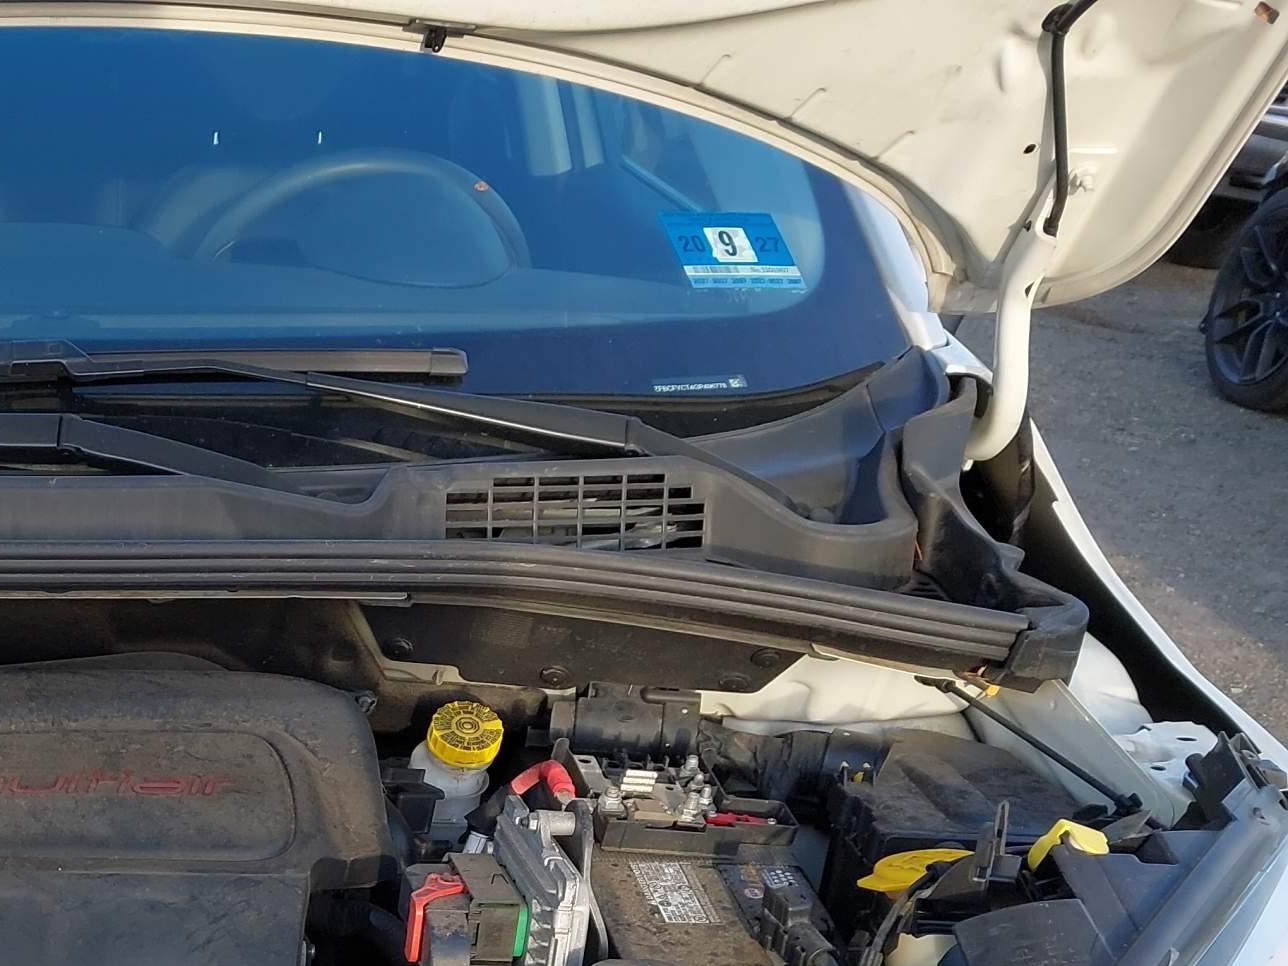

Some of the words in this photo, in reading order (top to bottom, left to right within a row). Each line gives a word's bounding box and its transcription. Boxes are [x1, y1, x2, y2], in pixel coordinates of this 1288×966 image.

[678, 235, 706, 253] 20
[718, 230, 738, 257] 9
[755, 236, 781, 253] 27
